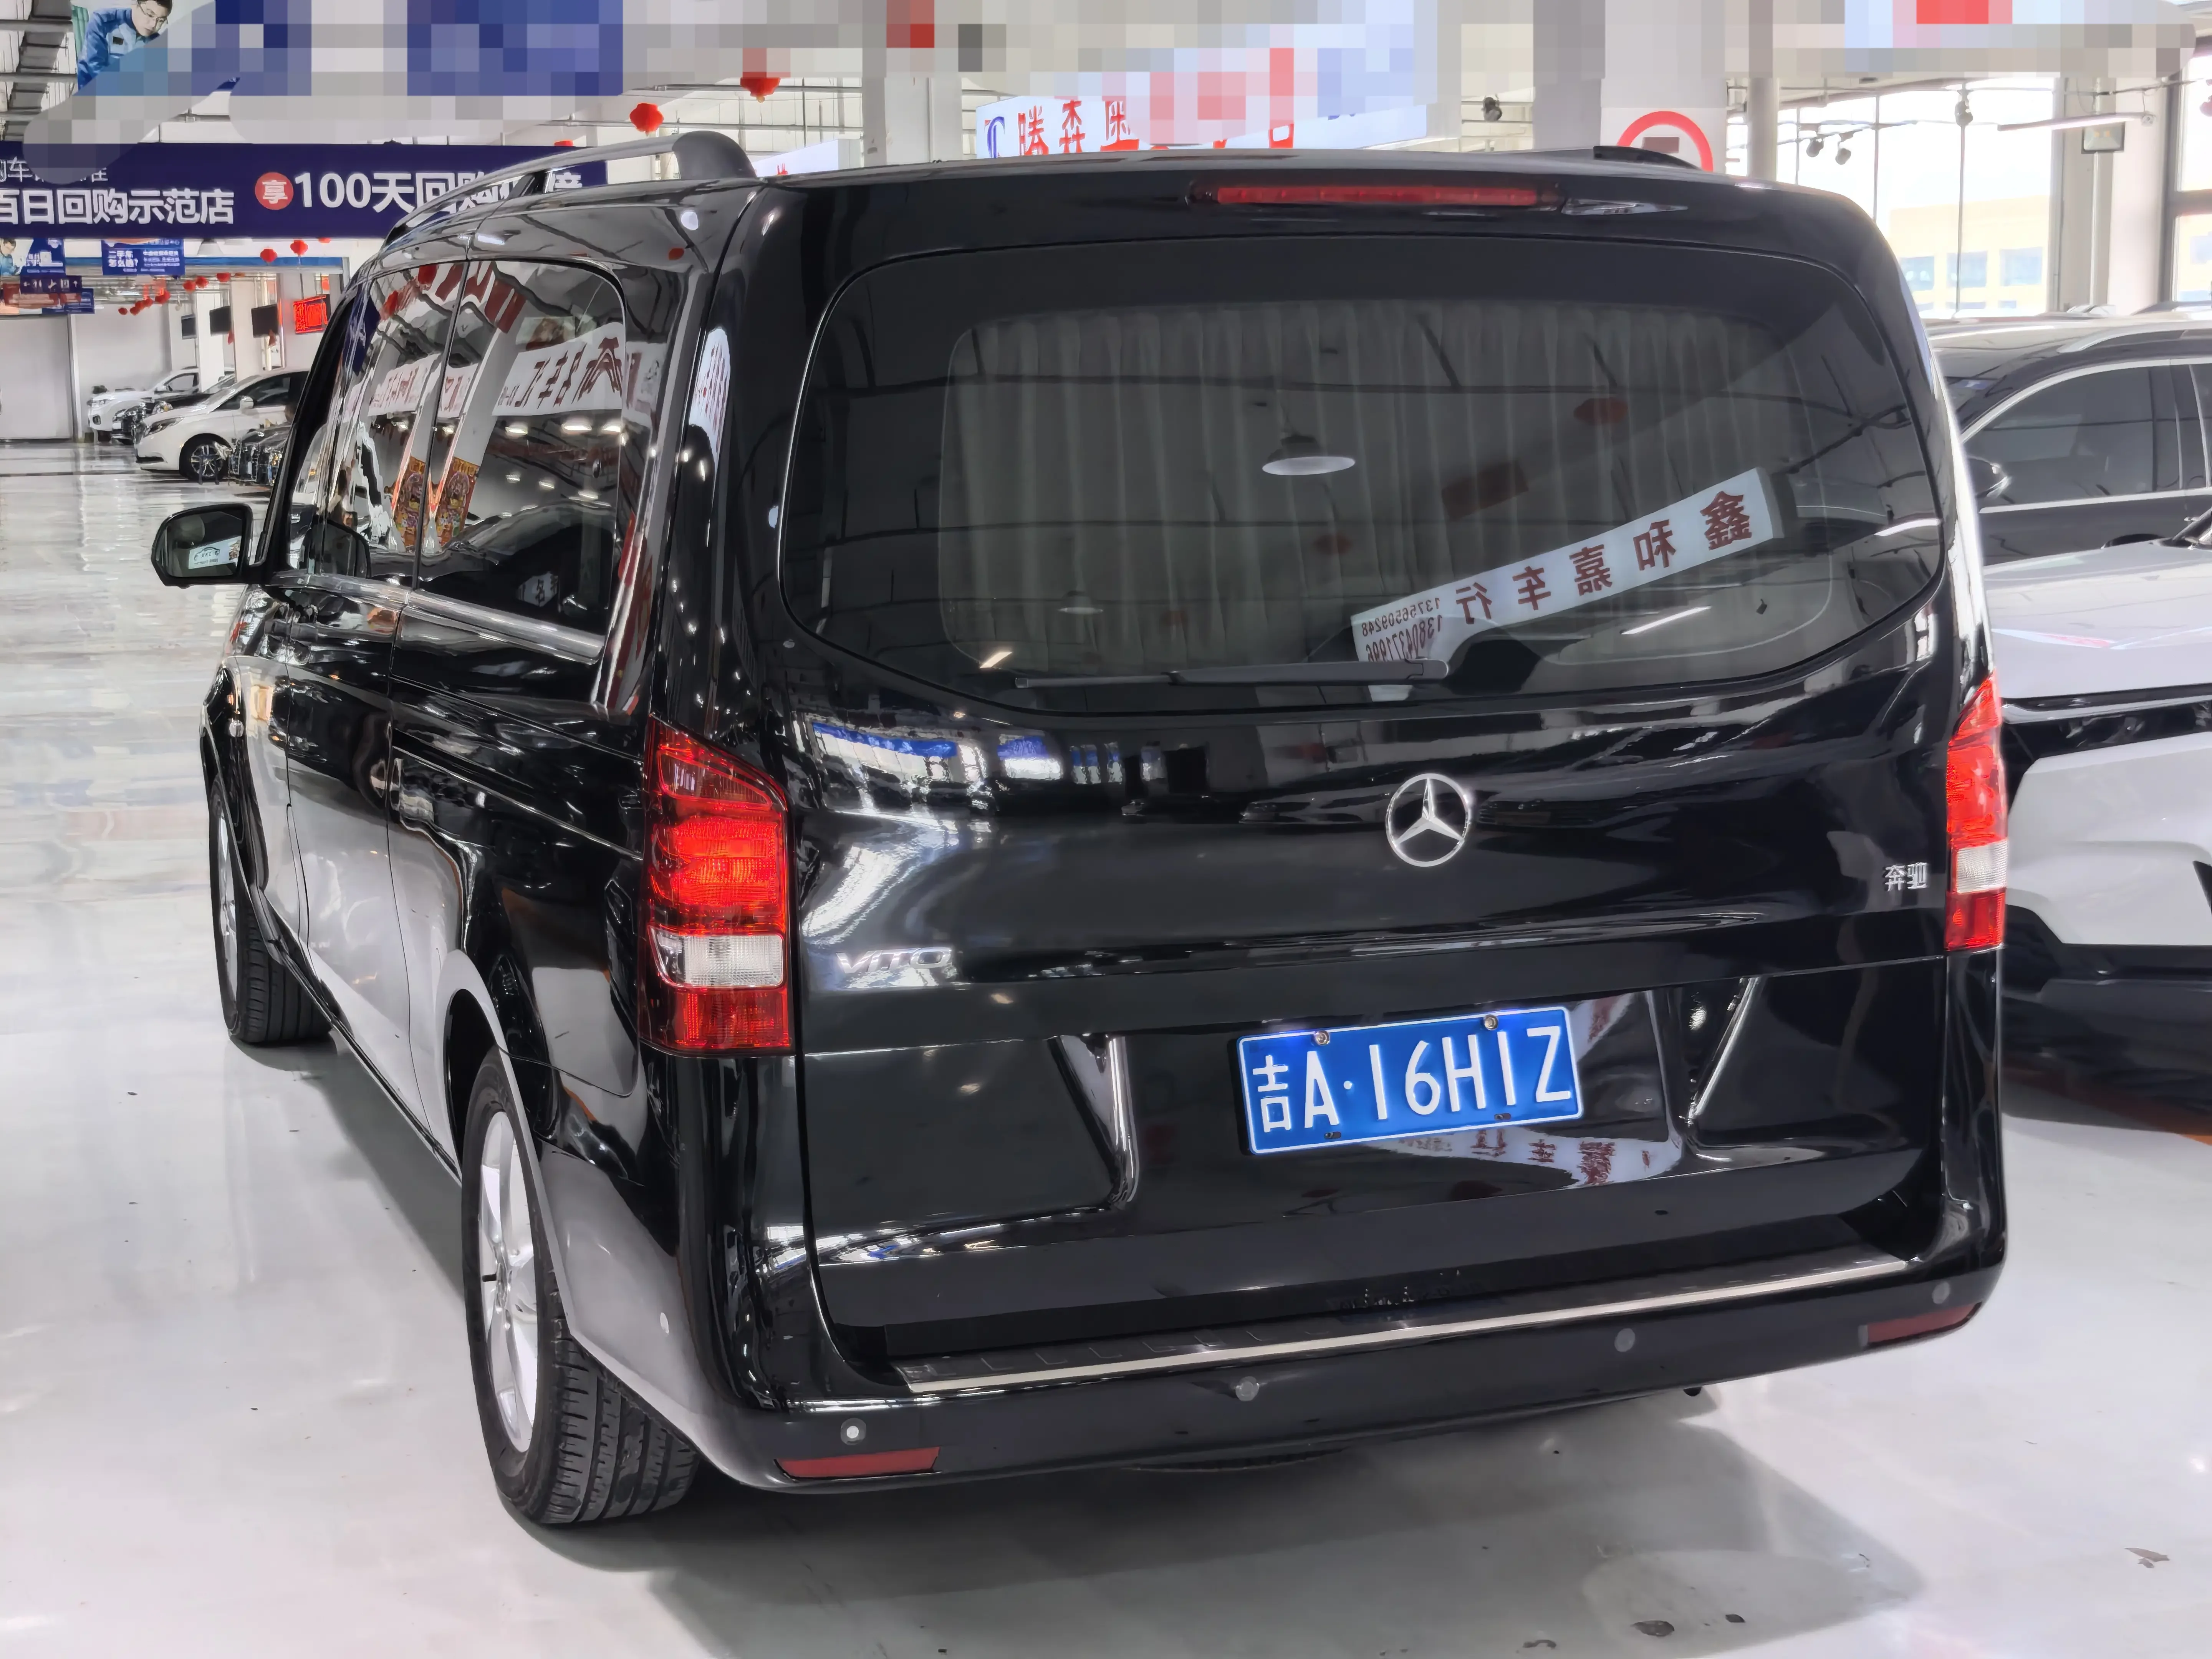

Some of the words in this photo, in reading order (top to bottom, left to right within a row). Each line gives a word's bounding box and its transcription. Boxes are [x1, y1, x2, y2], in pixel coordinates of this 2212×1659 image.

[0, 188, 234, 225] 百日回购示范店
[1885, 862, 1928, 892] 奔驰
[835, 947, 952, 974] VITO
